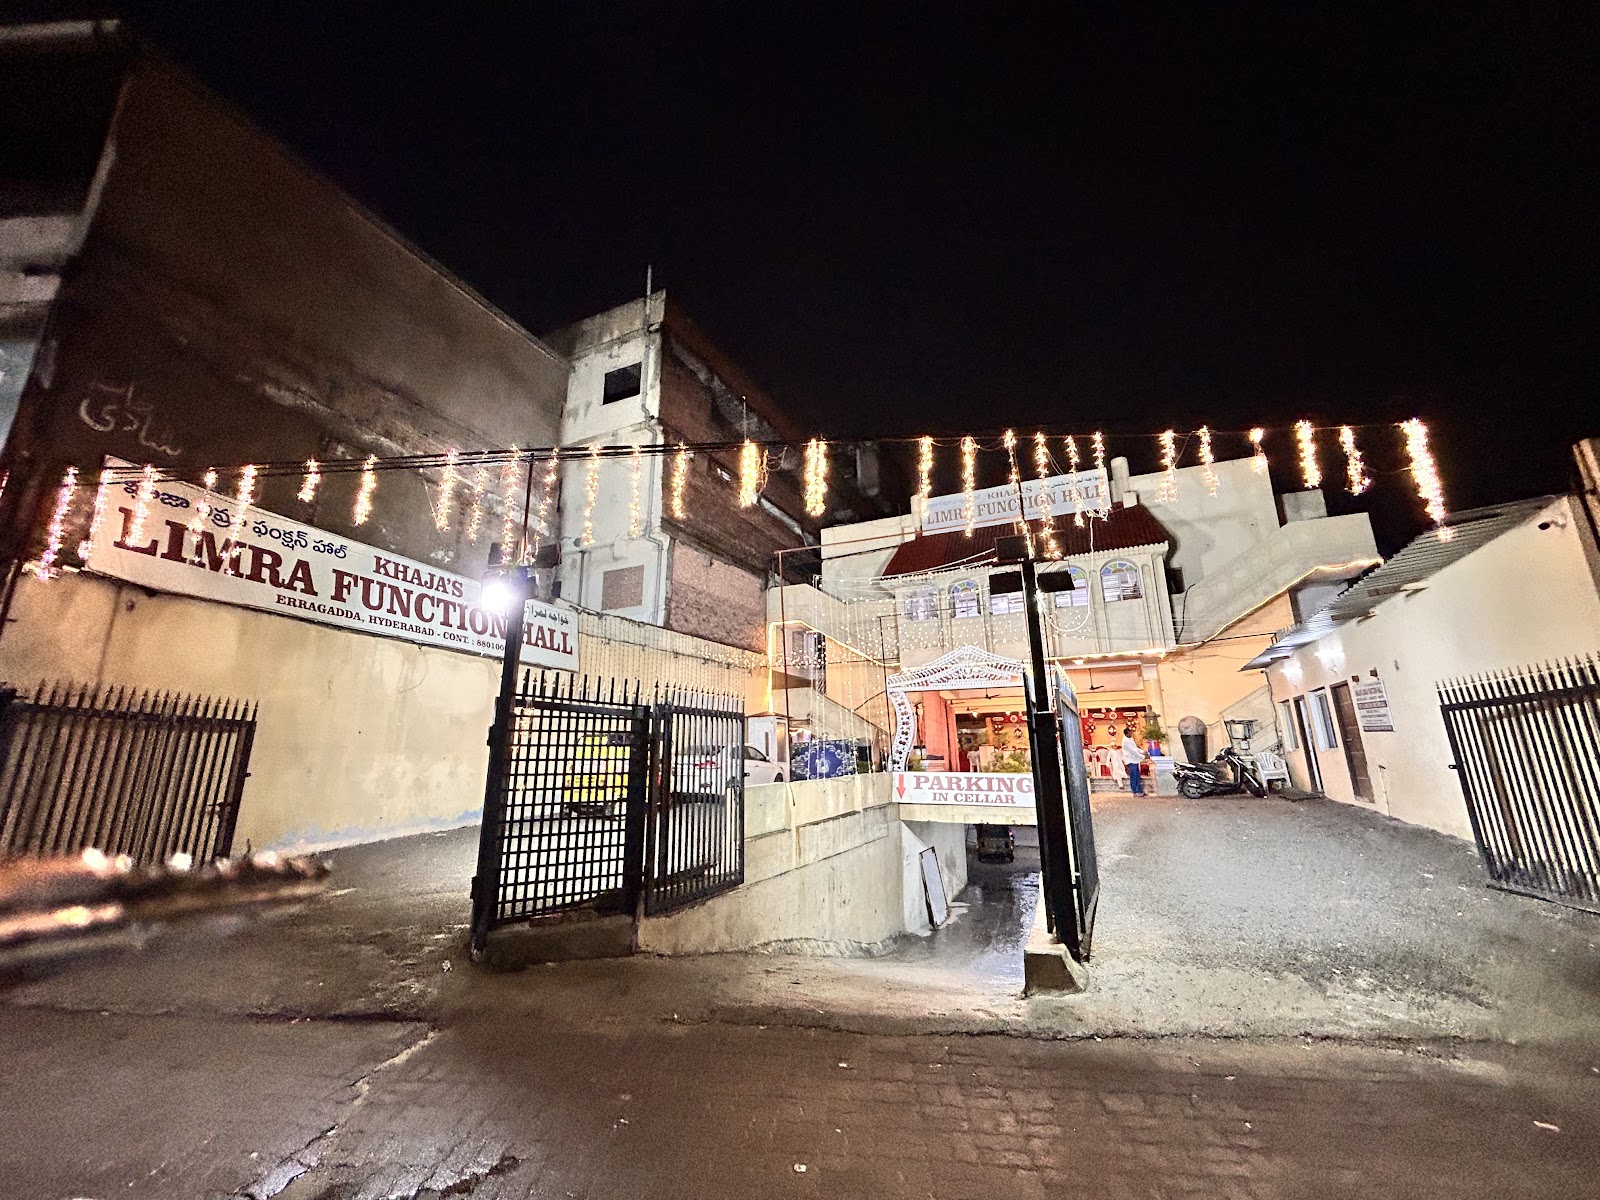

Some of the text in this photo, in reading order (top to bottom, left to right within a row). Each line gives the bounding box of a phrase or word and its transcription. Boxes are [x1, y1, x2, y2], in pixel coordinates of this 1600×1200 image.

[987, 485, 1033, 500] KHAJ'S
[926, 507, 973, 525] LIMR
[113, 506, 573, 656] LIMRA FUNCTION HALL
[373, 555, 463, 598] KHAJA'S
[275, 594, 364, 623] ERRAGADDA,
[368, 615, 434, 637] HYDERABAD
[443, 631, 469, 645] CONT.
[476, 639, 505, 652] 880100
[913, 775, 1034, 794] PARKING
[932, 792, 1017, 805] IN CELLAR
